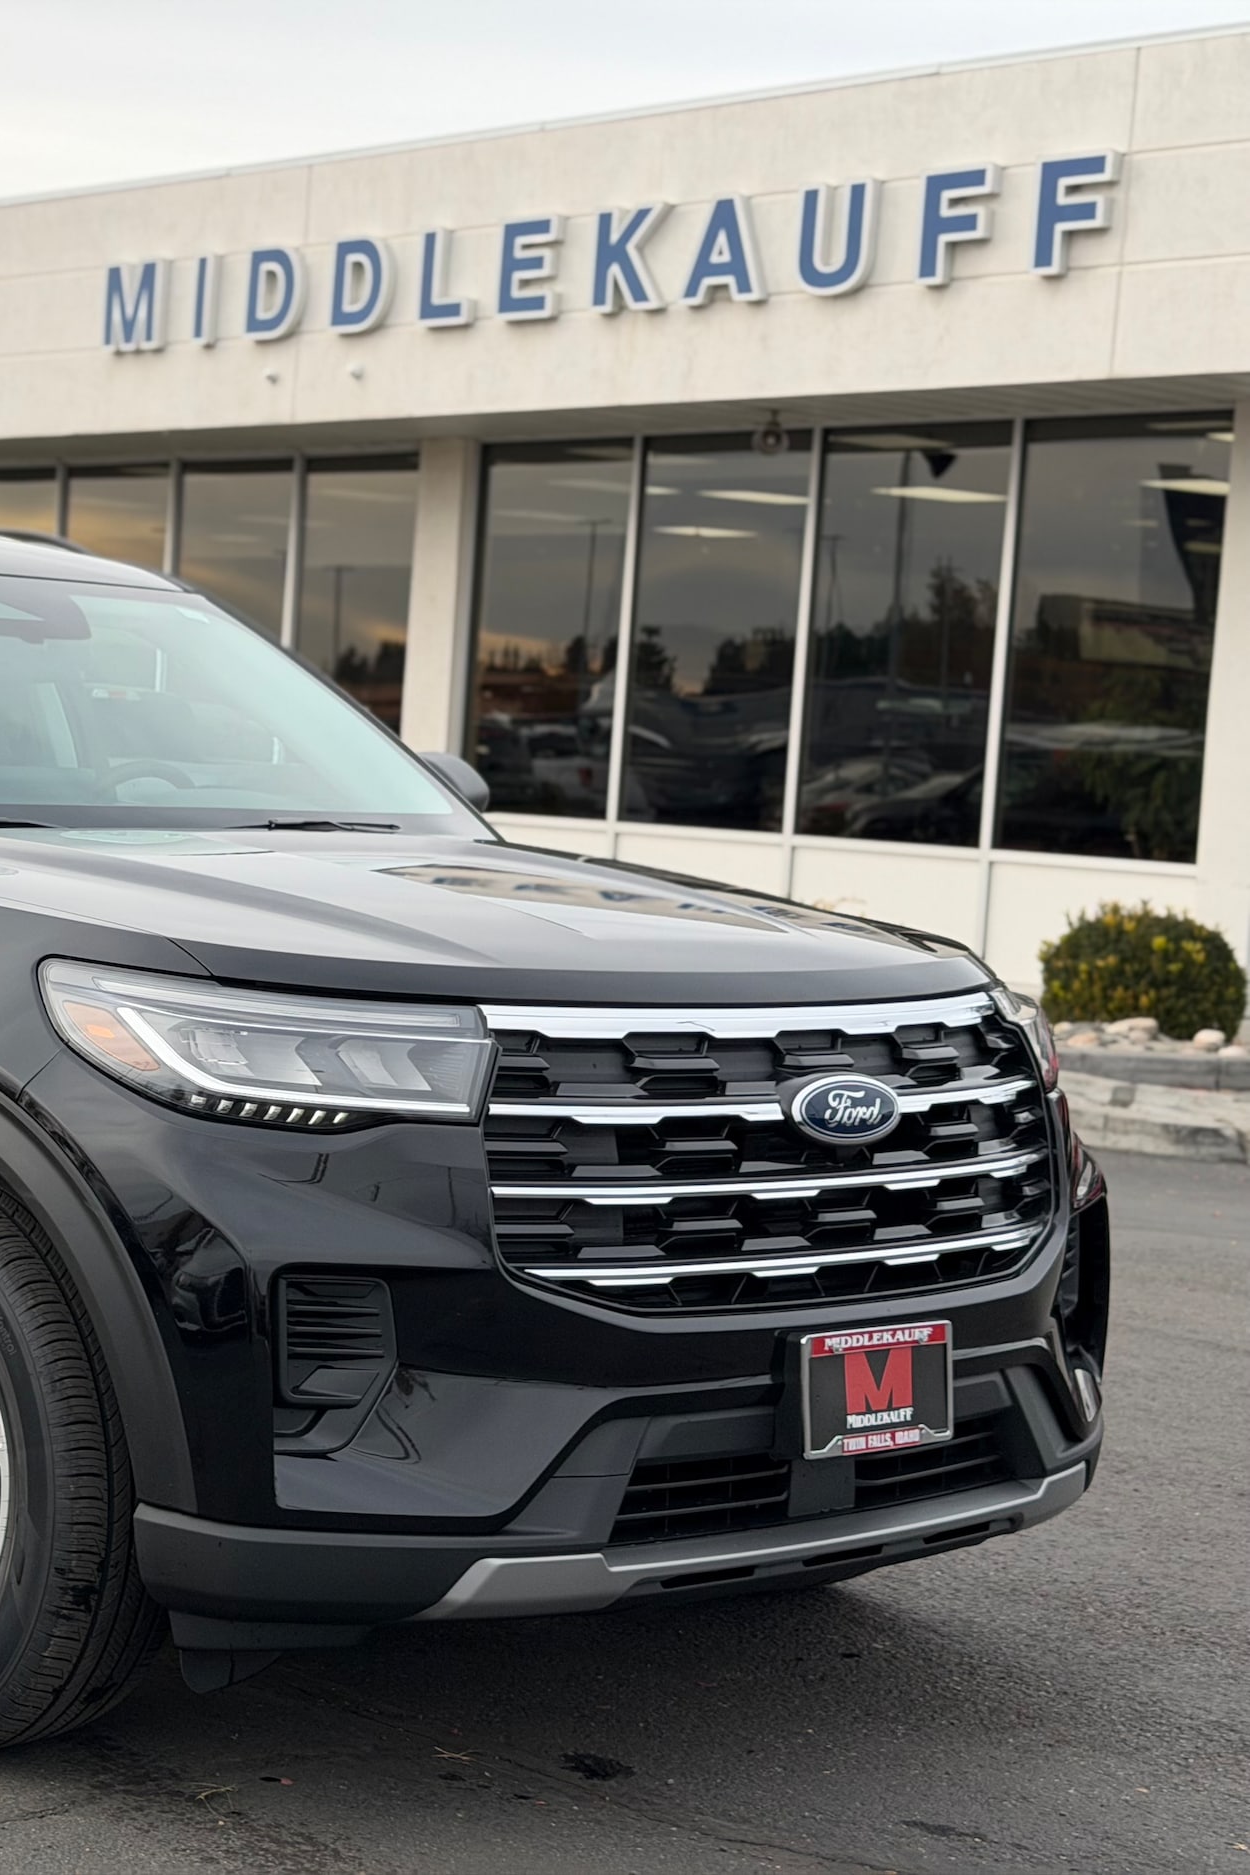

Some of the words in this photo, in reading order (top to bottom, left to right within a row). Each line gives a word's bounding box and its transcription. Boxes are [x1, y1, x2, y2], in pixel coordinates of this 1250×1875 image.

[104, 149, 1120, 353] MIDDLEKAUFF
[824, 1089, 882, 1128] Ford
[824, 1327, 933, 1351] MIDDLEKAUFF
[844, 1346, 913, 1414] M
[846, 1407, 914, 1429] MIDDLEKAUFF
